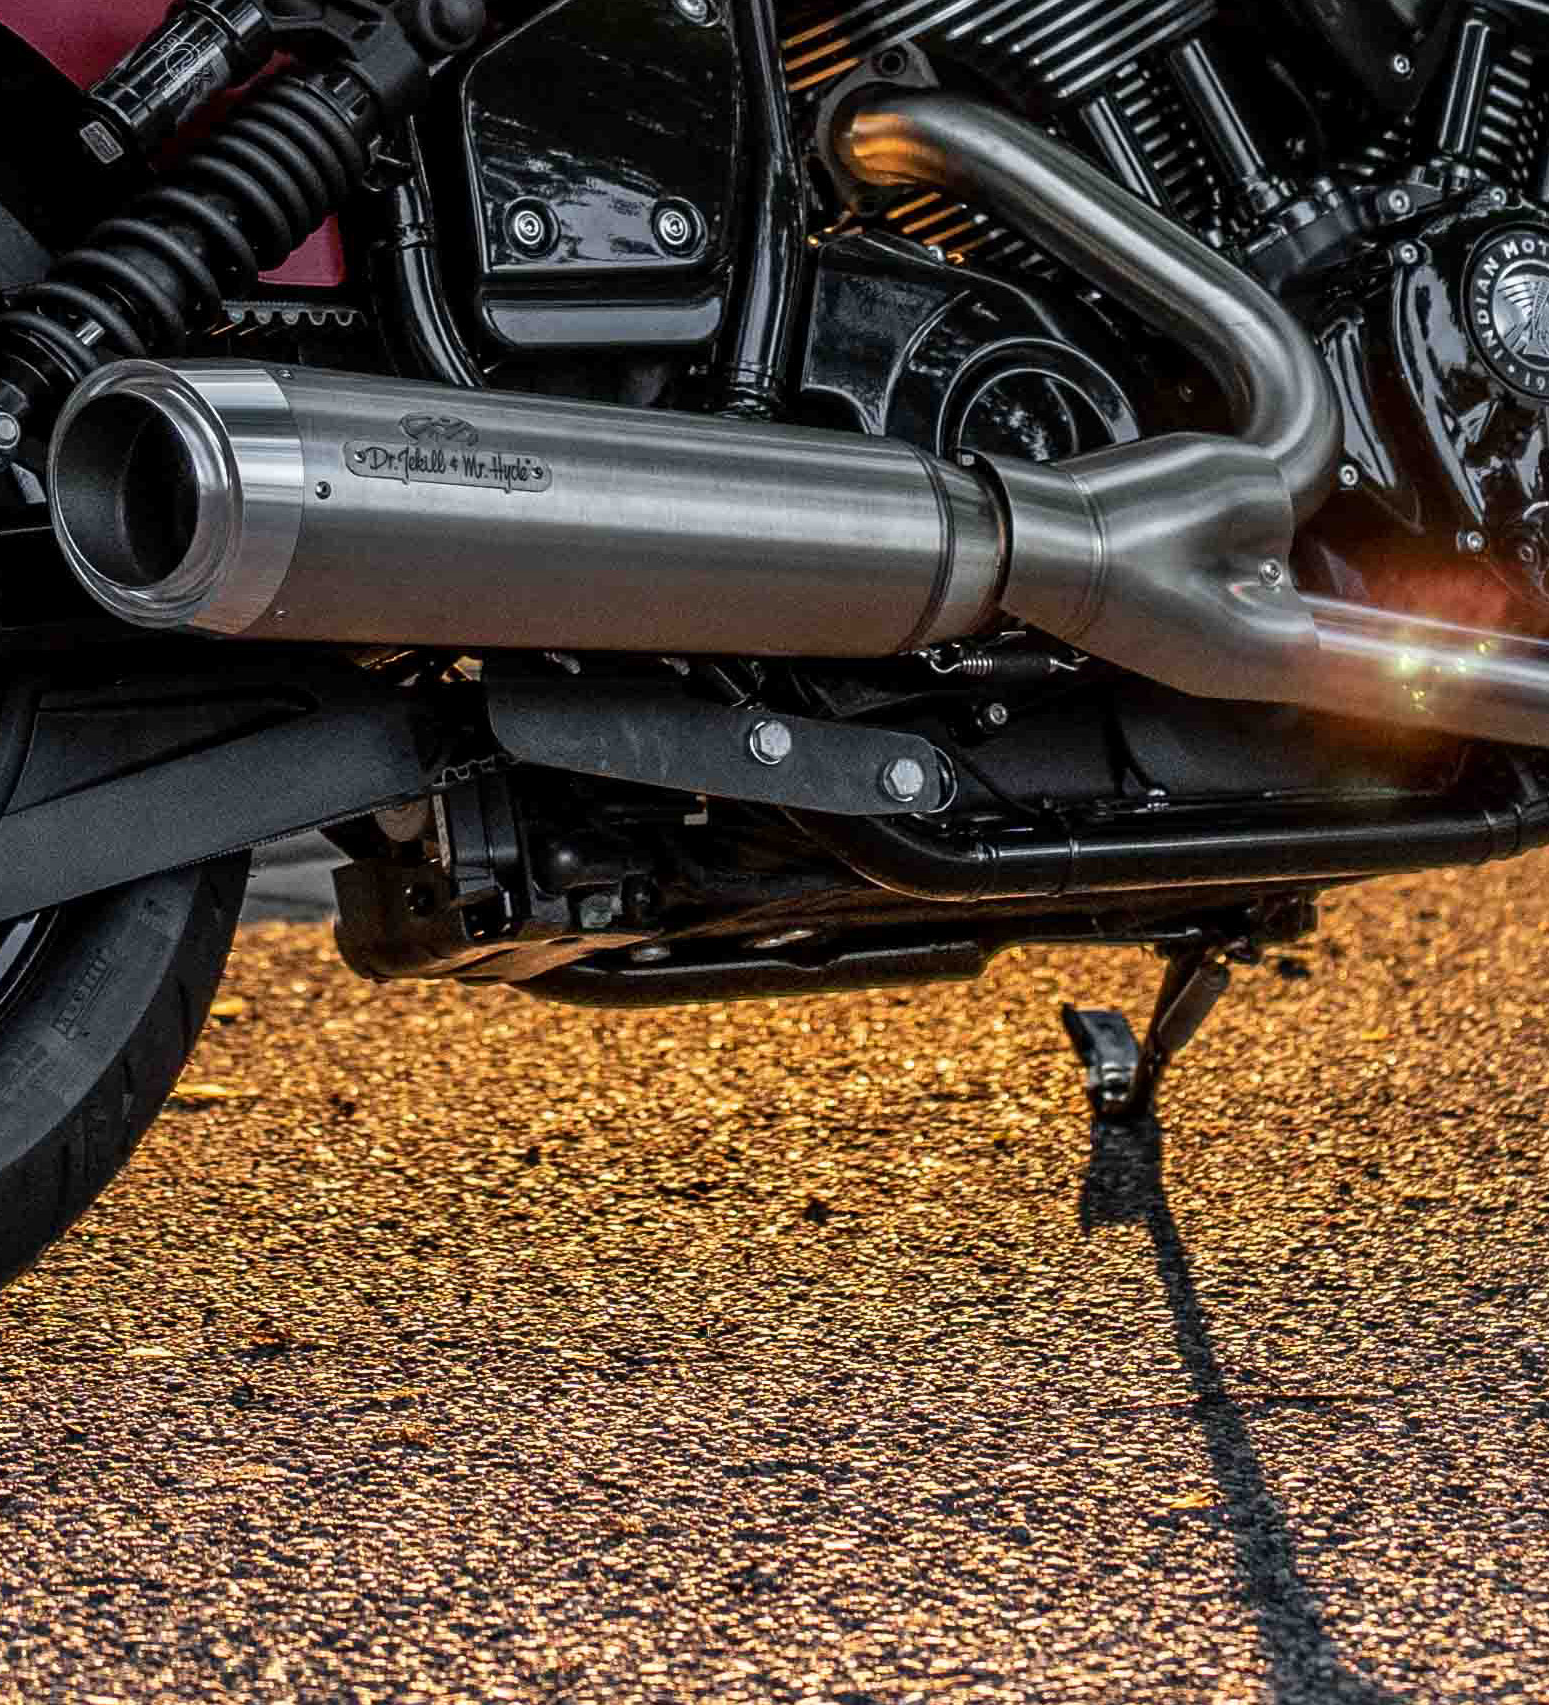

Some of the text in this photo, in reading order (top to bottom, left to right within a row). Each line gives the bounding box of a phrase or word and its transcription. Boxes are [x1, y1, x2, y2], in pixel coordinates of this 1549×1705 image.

[1475, 257, 1503, 360] INDIAN
[365, 446, 399, 471] Dr.
[400, 446, 447, 479] Jekill
[462, 455, 489, 479] Mr.
